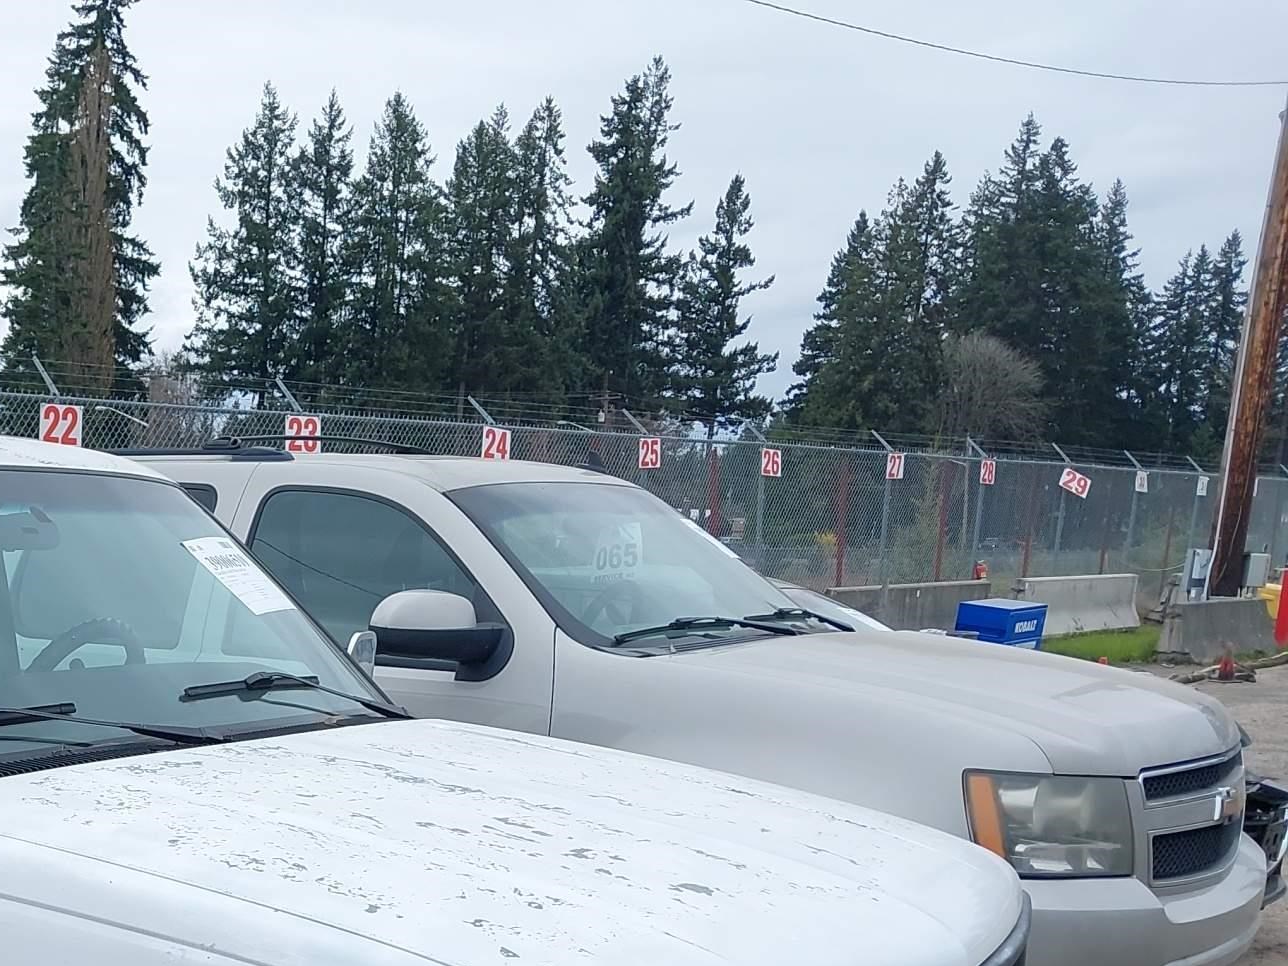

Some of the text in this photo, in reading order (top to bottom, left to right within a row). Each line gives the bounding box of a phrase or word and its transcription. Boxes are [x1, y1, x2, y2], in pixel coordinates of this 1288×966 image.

[43, 405, 78, 446] 22
[288, 417, 318, 453] 23
[484, 428, 508, 460] 24
[640, 439, 660, 468] 25
[763, 450, 780, 475] 26
[887, 454, 902, 478] 27
[981, 460, 995, 484] 28
[1062, 470, 1088, 496] 29
